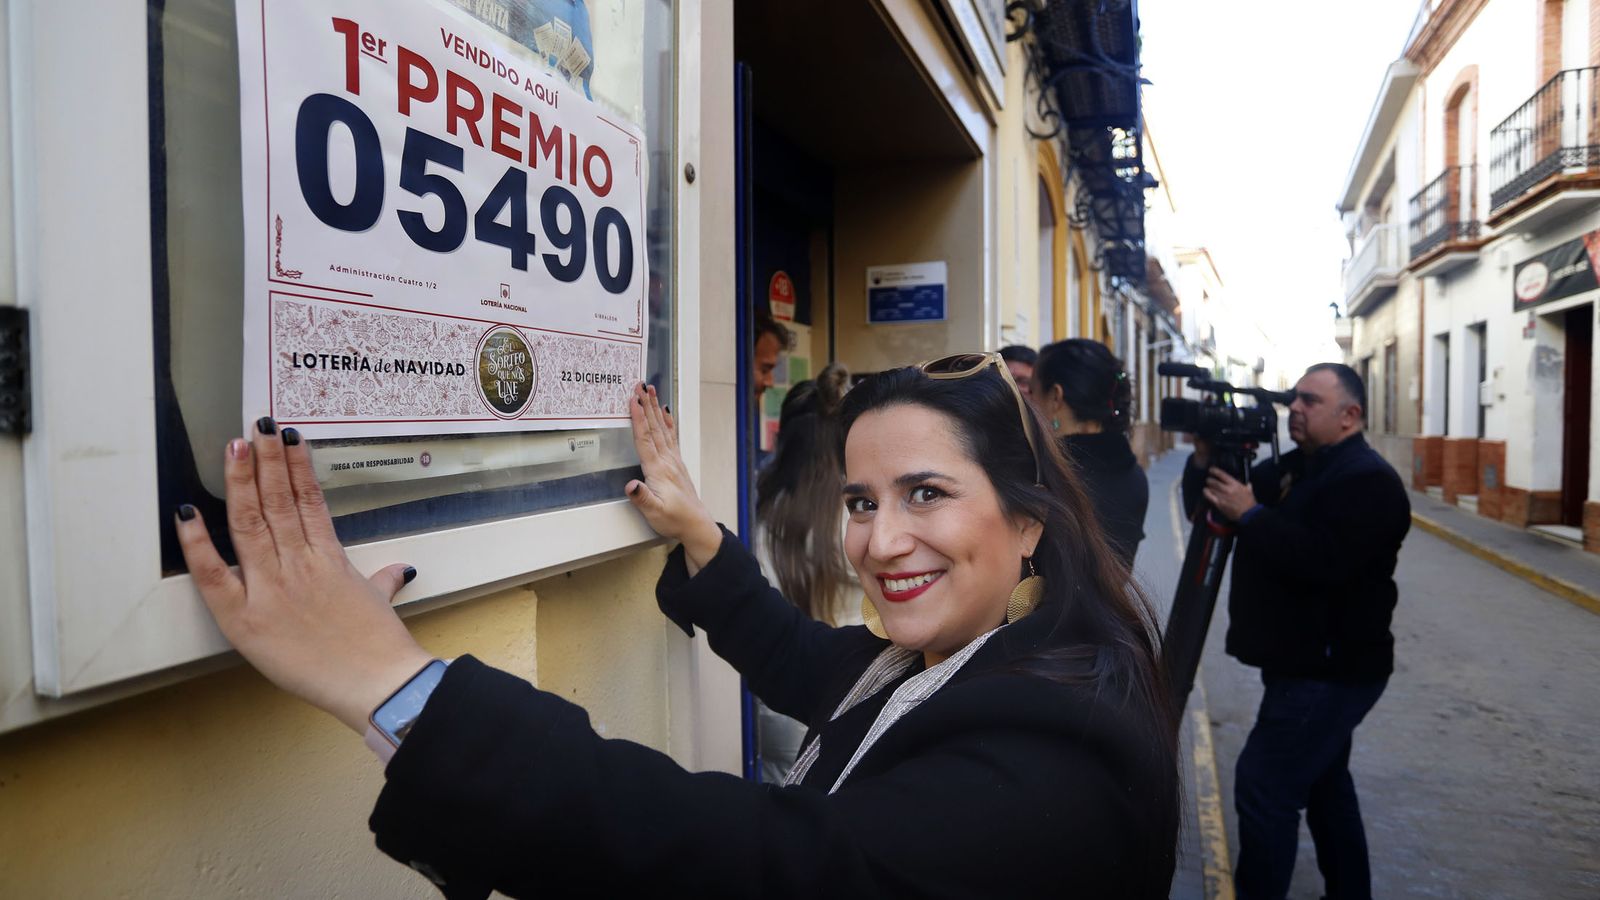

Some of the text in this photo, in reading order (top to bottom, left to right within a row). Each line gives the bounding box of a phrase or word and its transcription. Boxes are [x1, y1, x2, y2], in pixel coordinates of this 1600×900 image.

[440, 27, 559, 109] VENDIDO AQUÍ
[398, 45, 613, 198] PREMIO
[295, 92, 634, 295] 05490
[329, 264, 437, 290] Administración Cuatro 1/2
[480, 299, 528, 313] LOTERÍA NACIONAL
[293, 352, 465, 376] LOTERÍA de NAVIDAD
[561, 371, 622, 384] 22 DICIEMBRE
[331, 457, 414, 471] JUEGA CON RESPONSABILIDAD
